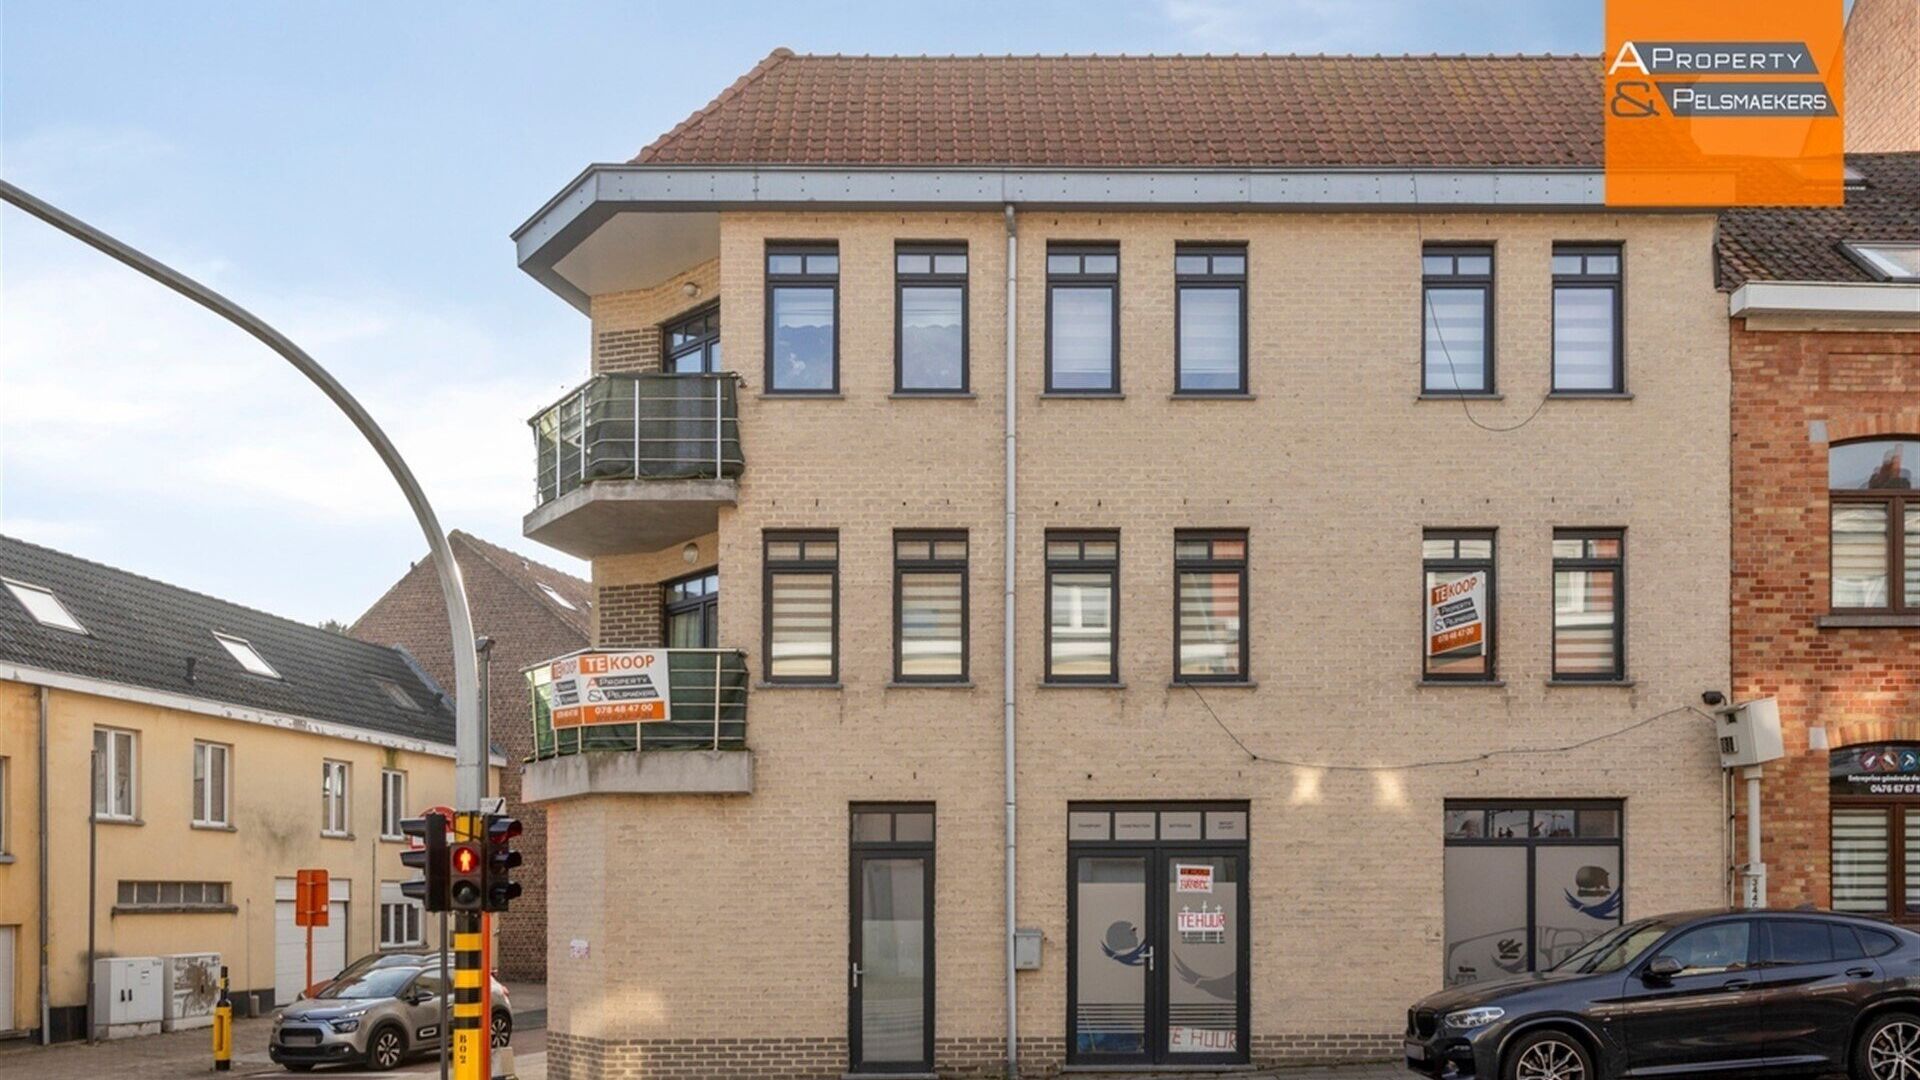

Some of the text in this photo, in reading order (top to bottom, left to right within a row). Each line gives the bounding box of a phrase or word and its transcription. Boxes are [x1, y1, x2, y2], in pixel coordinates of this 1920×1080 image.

[1449, 576, 1477, 597] KOOP
[586, 655, 655, 671] TE KOOP
[594, 703, 653, 715] 078 48 47 00
